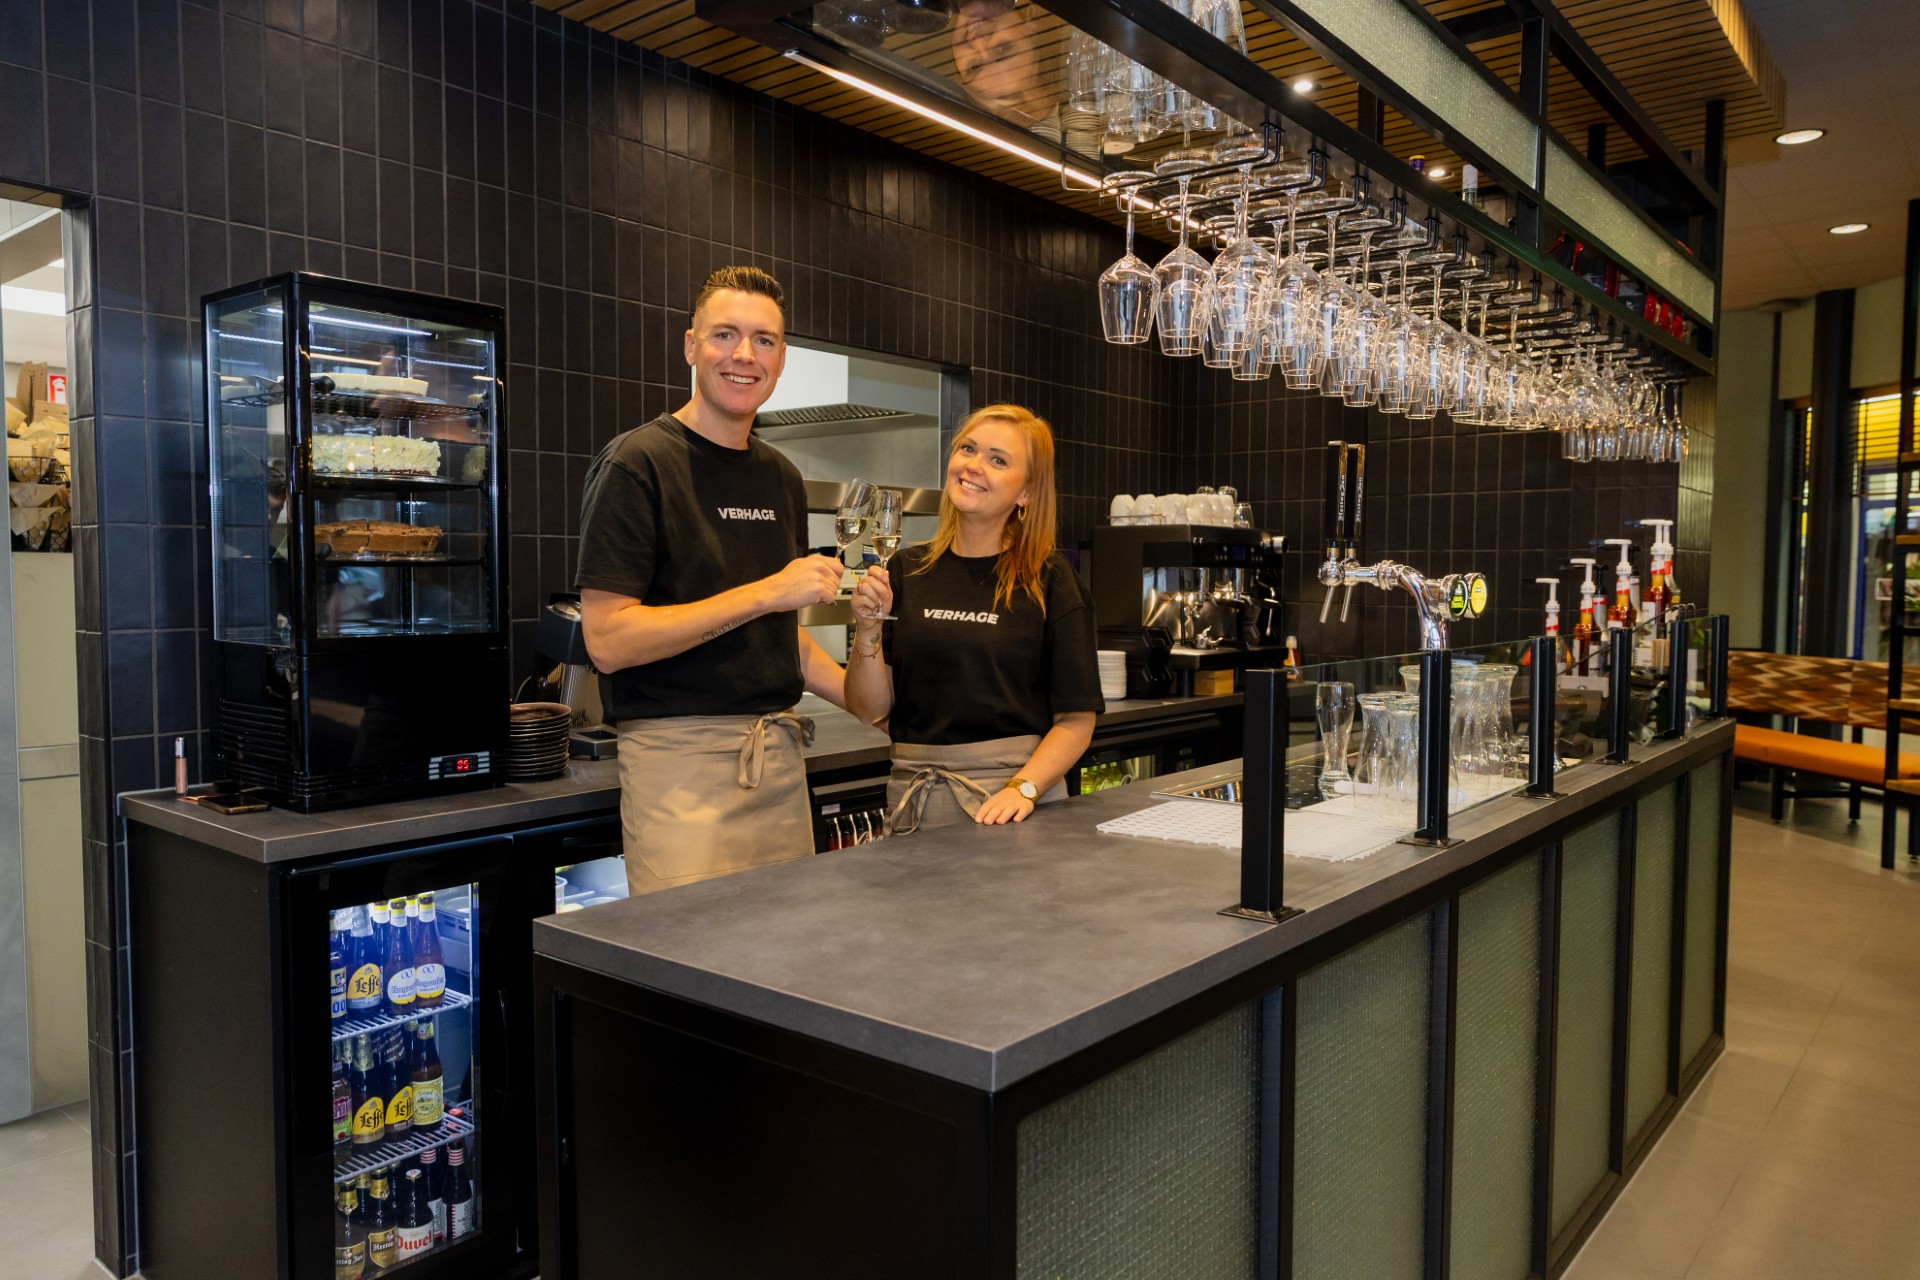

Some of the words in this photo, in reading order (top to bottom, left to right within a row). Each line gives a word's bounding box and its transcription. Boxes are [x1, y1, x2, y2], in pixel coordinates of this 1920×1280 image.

[717, 507, 776, 521] VERHAGE
[923, 608, 999, 625] VERHAGE
[355, 974, 380, 995] Leffe
[360, 1108, 383, 1129] Leffe
[398, 1230, 432, 1250] Duvel
